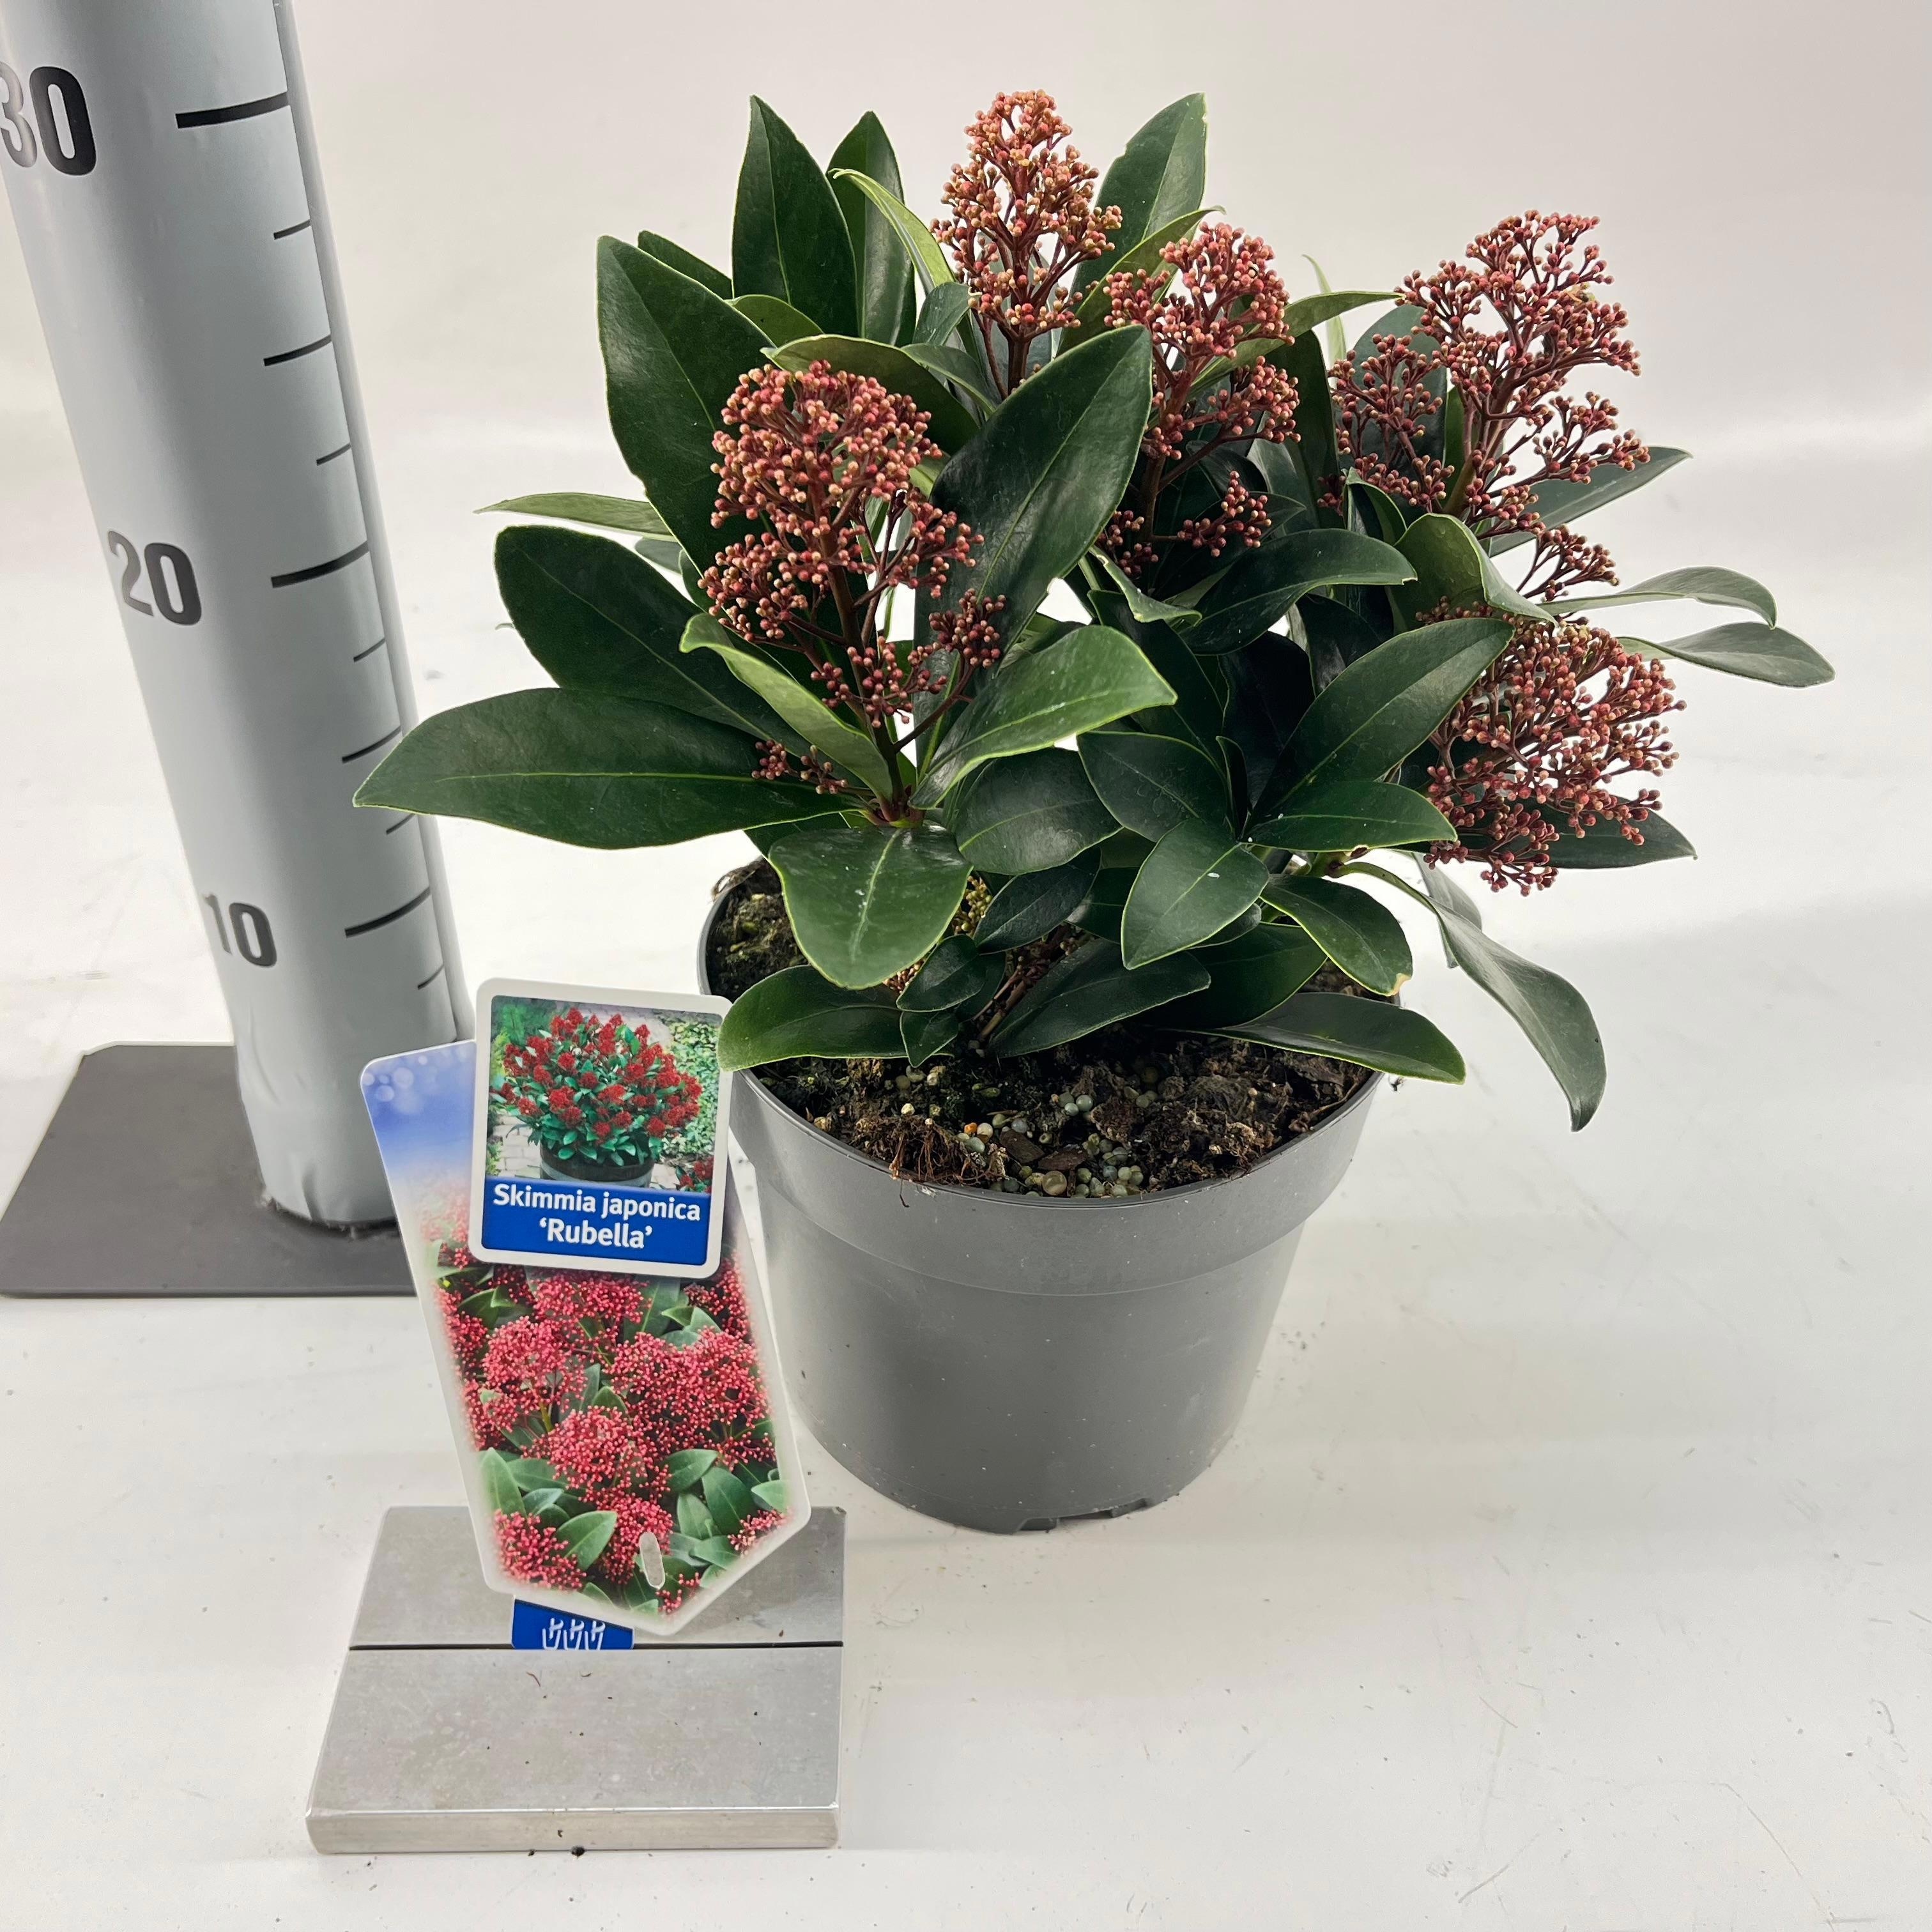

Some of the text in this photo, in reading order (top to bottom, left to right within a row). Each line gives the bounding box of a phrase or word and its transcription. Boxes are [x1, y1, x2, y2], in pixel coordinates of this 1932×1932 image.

[107, 530, 202, 625] 20
[204, 894, 277, 967] 10
[493, 1183, 701, 1221] Skimmia japonica
[539, 1216, 653, 1249] ‘Rubella’
